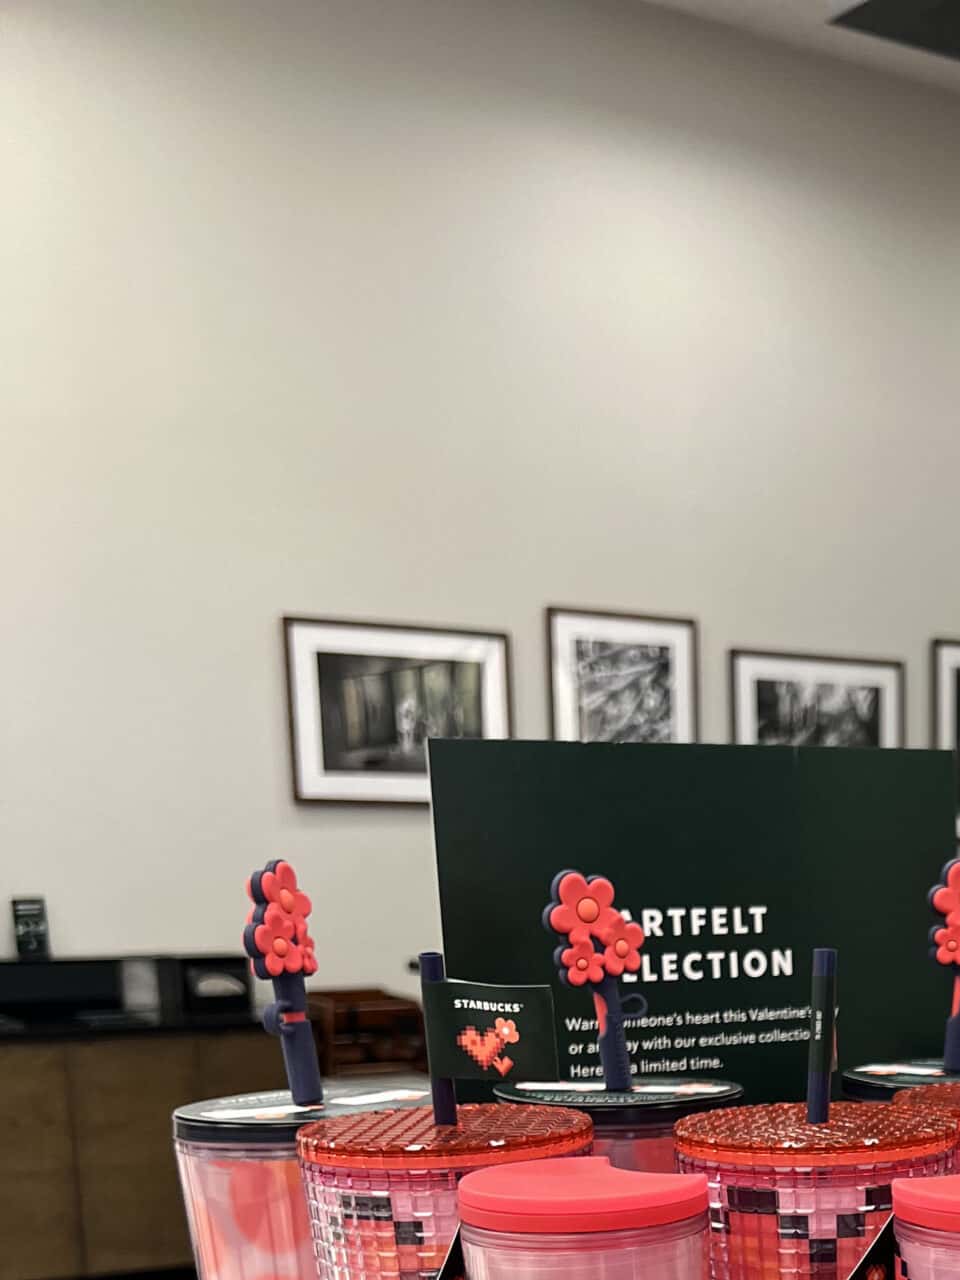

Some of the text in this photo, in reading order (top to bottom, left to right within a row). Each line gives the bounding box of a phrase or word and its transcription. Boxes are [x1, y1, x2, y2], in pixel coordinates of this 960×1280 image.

[620, 905, 768, 937] RTFELT
[621, 948, 793, 983] LECTION
[453, 999, 522, 1013] STARBUCKS
[565, 1017, 600, 1031] War
[685, 1010, 721, 1024] heart
[722, 1008, 748, 1023] this
[568, 1043, 584, 1055] or
[641, 1035, 671, 1050] with
[674, 1037, 697, 1048] our
[698, 1032, 756, 1047] exclusive
[758, 1028, 811, 1042] collectio
[570, 1064, 604, 1078] Here
[640, 1056, 687, 1073] limited
[690, 1056, 724, 1070] time.
